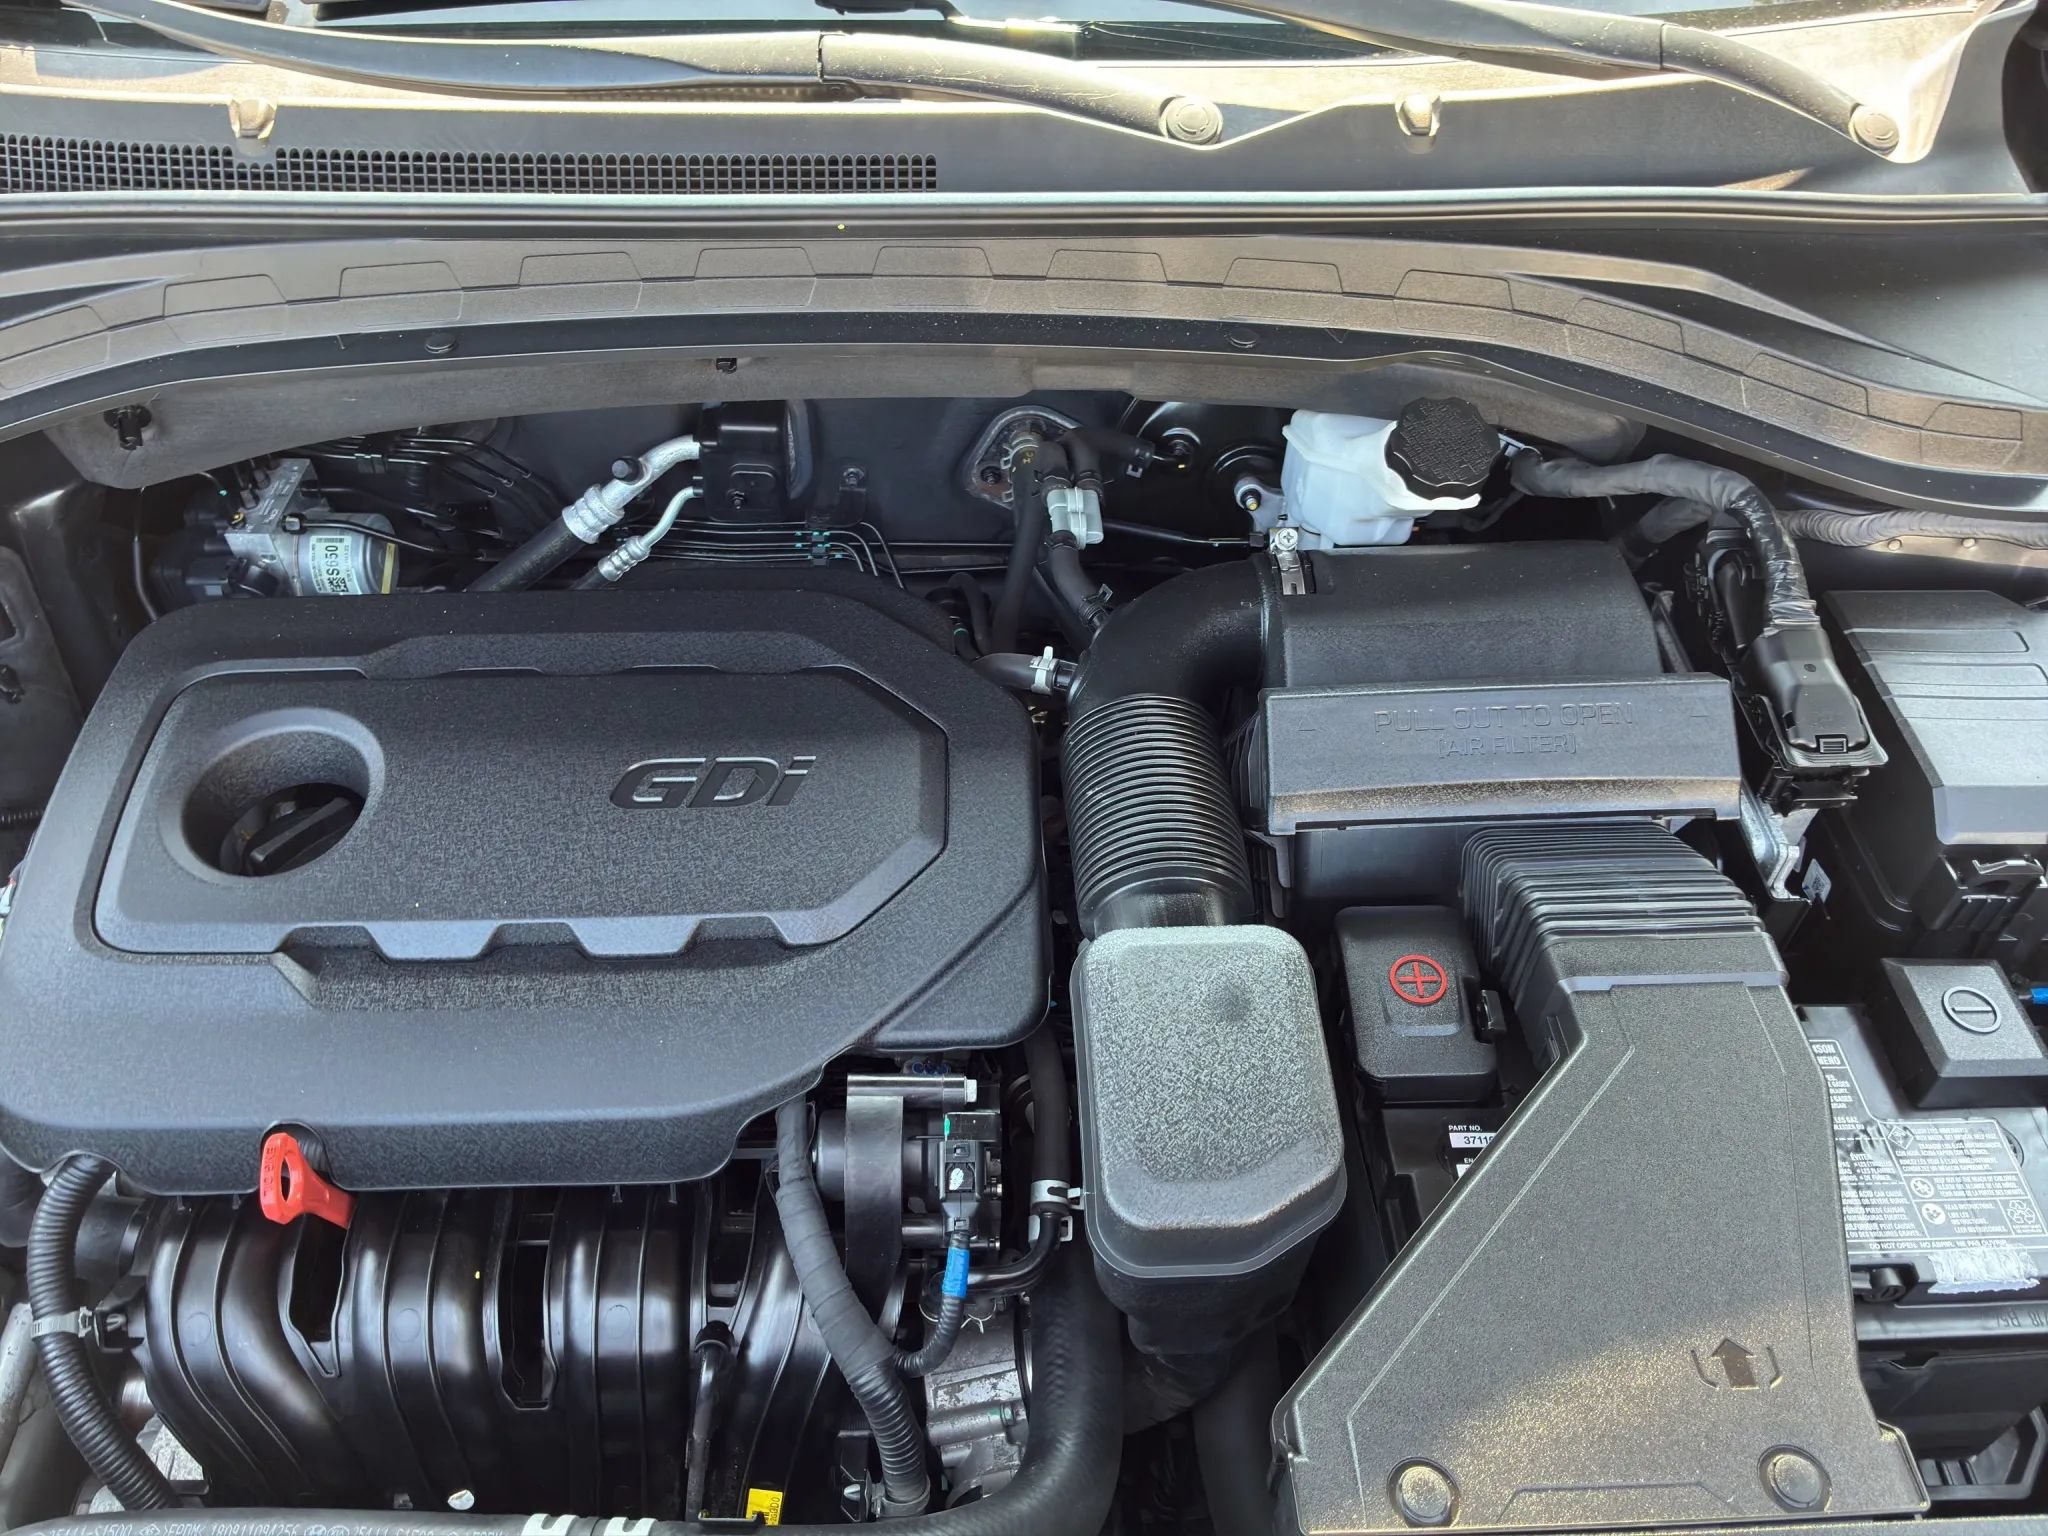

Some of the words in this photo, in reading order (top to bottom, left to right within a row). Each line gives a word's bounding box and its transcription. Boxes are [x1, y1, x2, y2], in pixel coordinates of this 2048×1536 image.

[325, 545, 340, 576] S650
[1373, 709, 1445, 733] PULL
[1452, 706, 1508, 729] OUT
[1514, 705, 1551, 727] TO
[1559, 702, 1633, 725] OPEN
[610, 756, 817, 809] GDi
